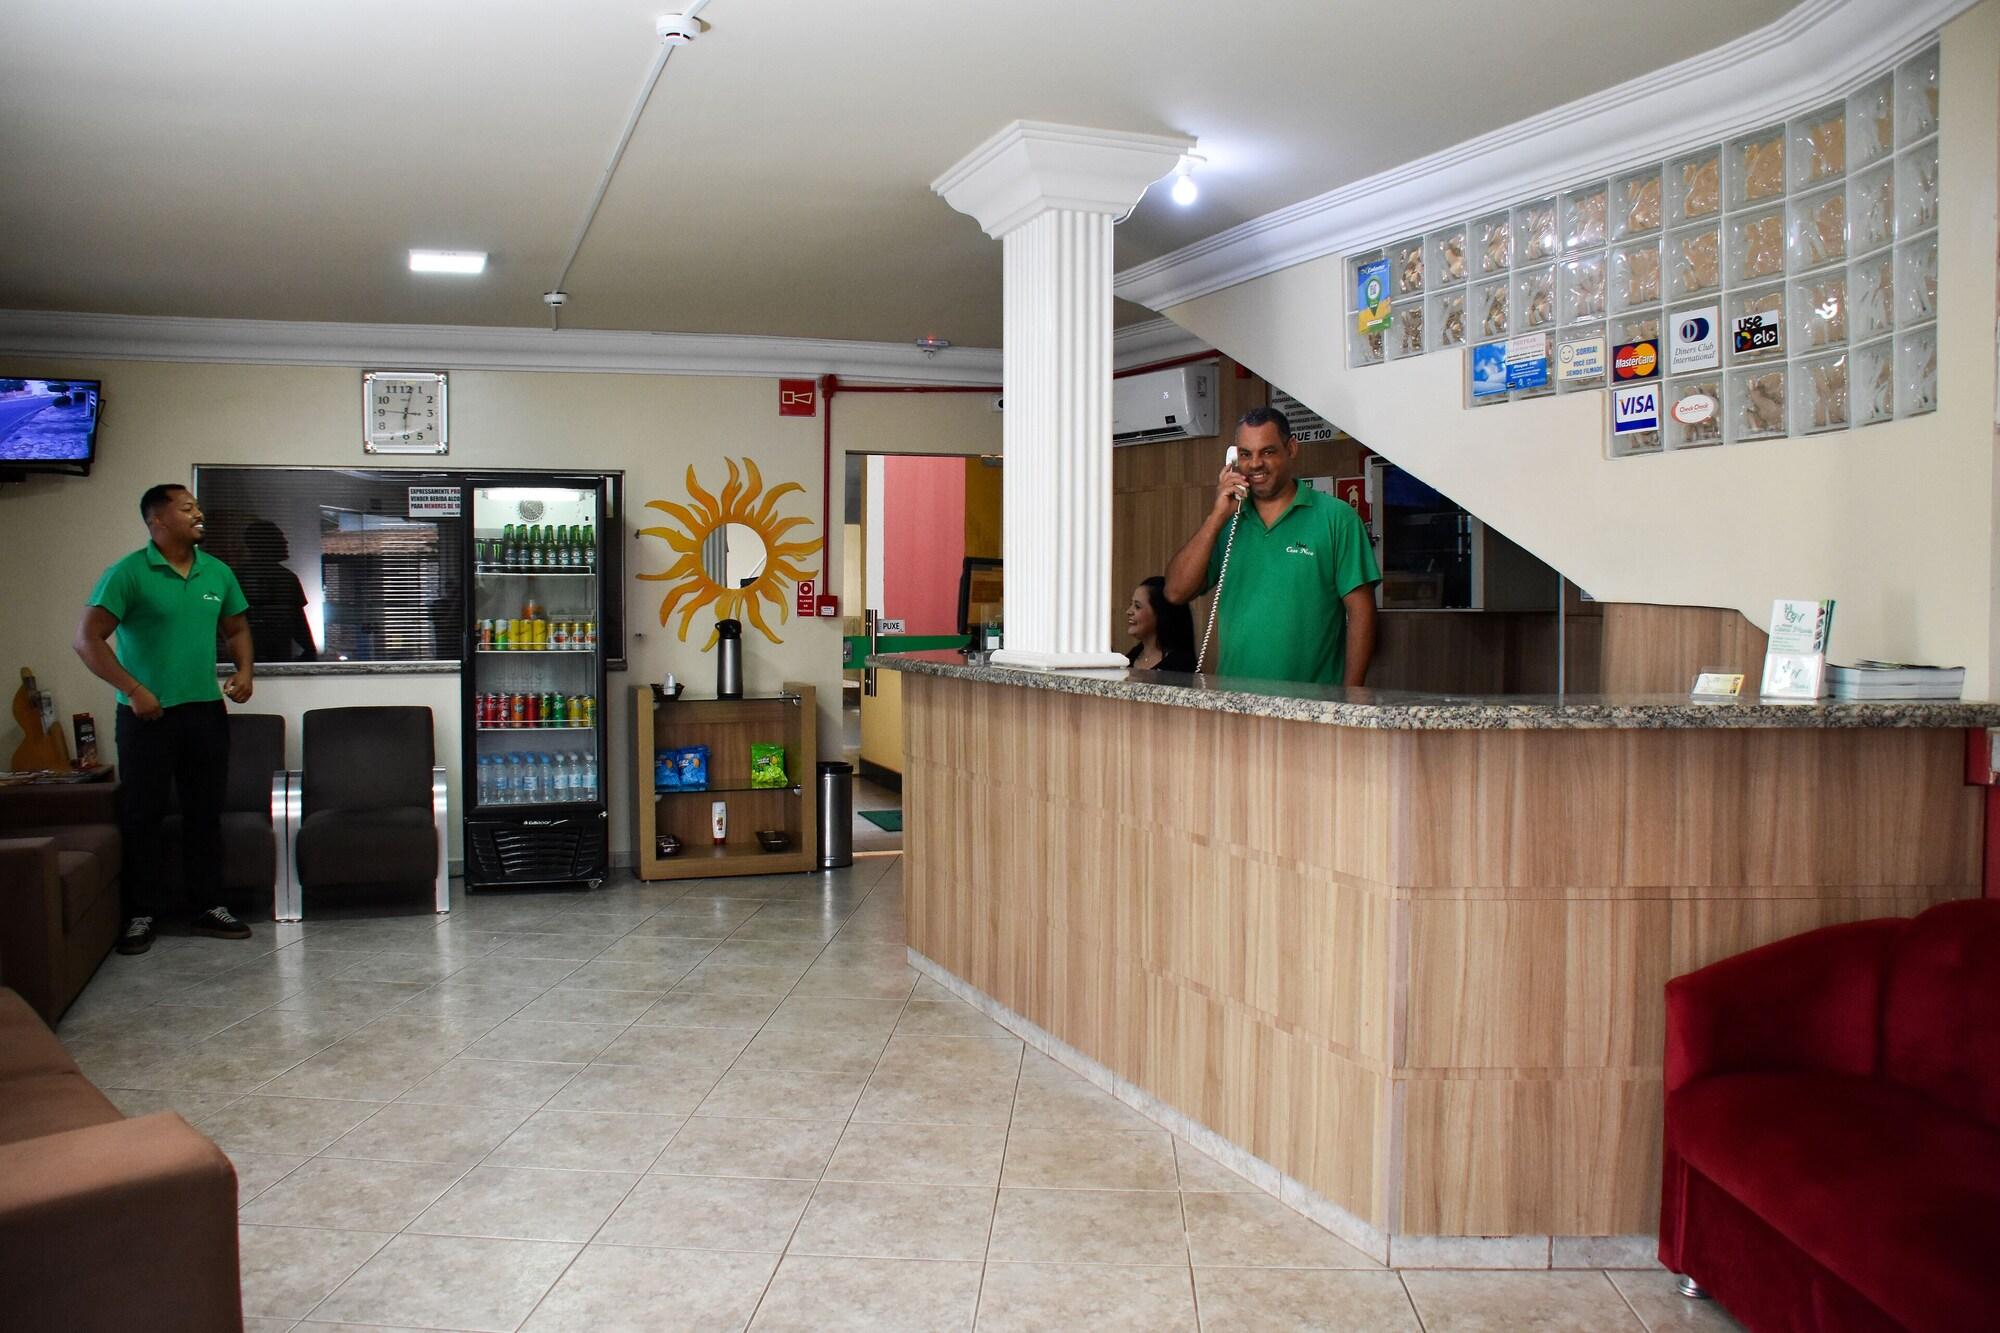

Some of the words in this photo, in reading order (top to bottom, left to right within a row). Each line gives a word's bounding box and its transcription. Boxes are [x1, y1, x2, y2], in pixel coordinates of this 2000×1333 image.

[1738, 315, 1762, 330] use
[1753, 329, 1776, 345] elo
[1675, 346, 1696, 356] Diners
[1697, 342, 1714, 352] Club
[1615, 354, 1655, 369] MasterCard
[1673, 350, 1716, 365] International
[386, 385, 397, 394] 11
[400, 385, 412, 394] 12
[418, 386, 422, 394] 1
[378, 396, 390, 404] 10
[426, 395, 433, 404] 2
[1618, 394, 1655, 416] VISA
[378, 409, 386, 417] 9
[426, 409, 433, 417] 3
[378, 422, 386, 430] 8
[417, 432, 423, 441] 5
[1314, 428, 1331, 439] 100
[882, 622, 900, 630] PUXE
